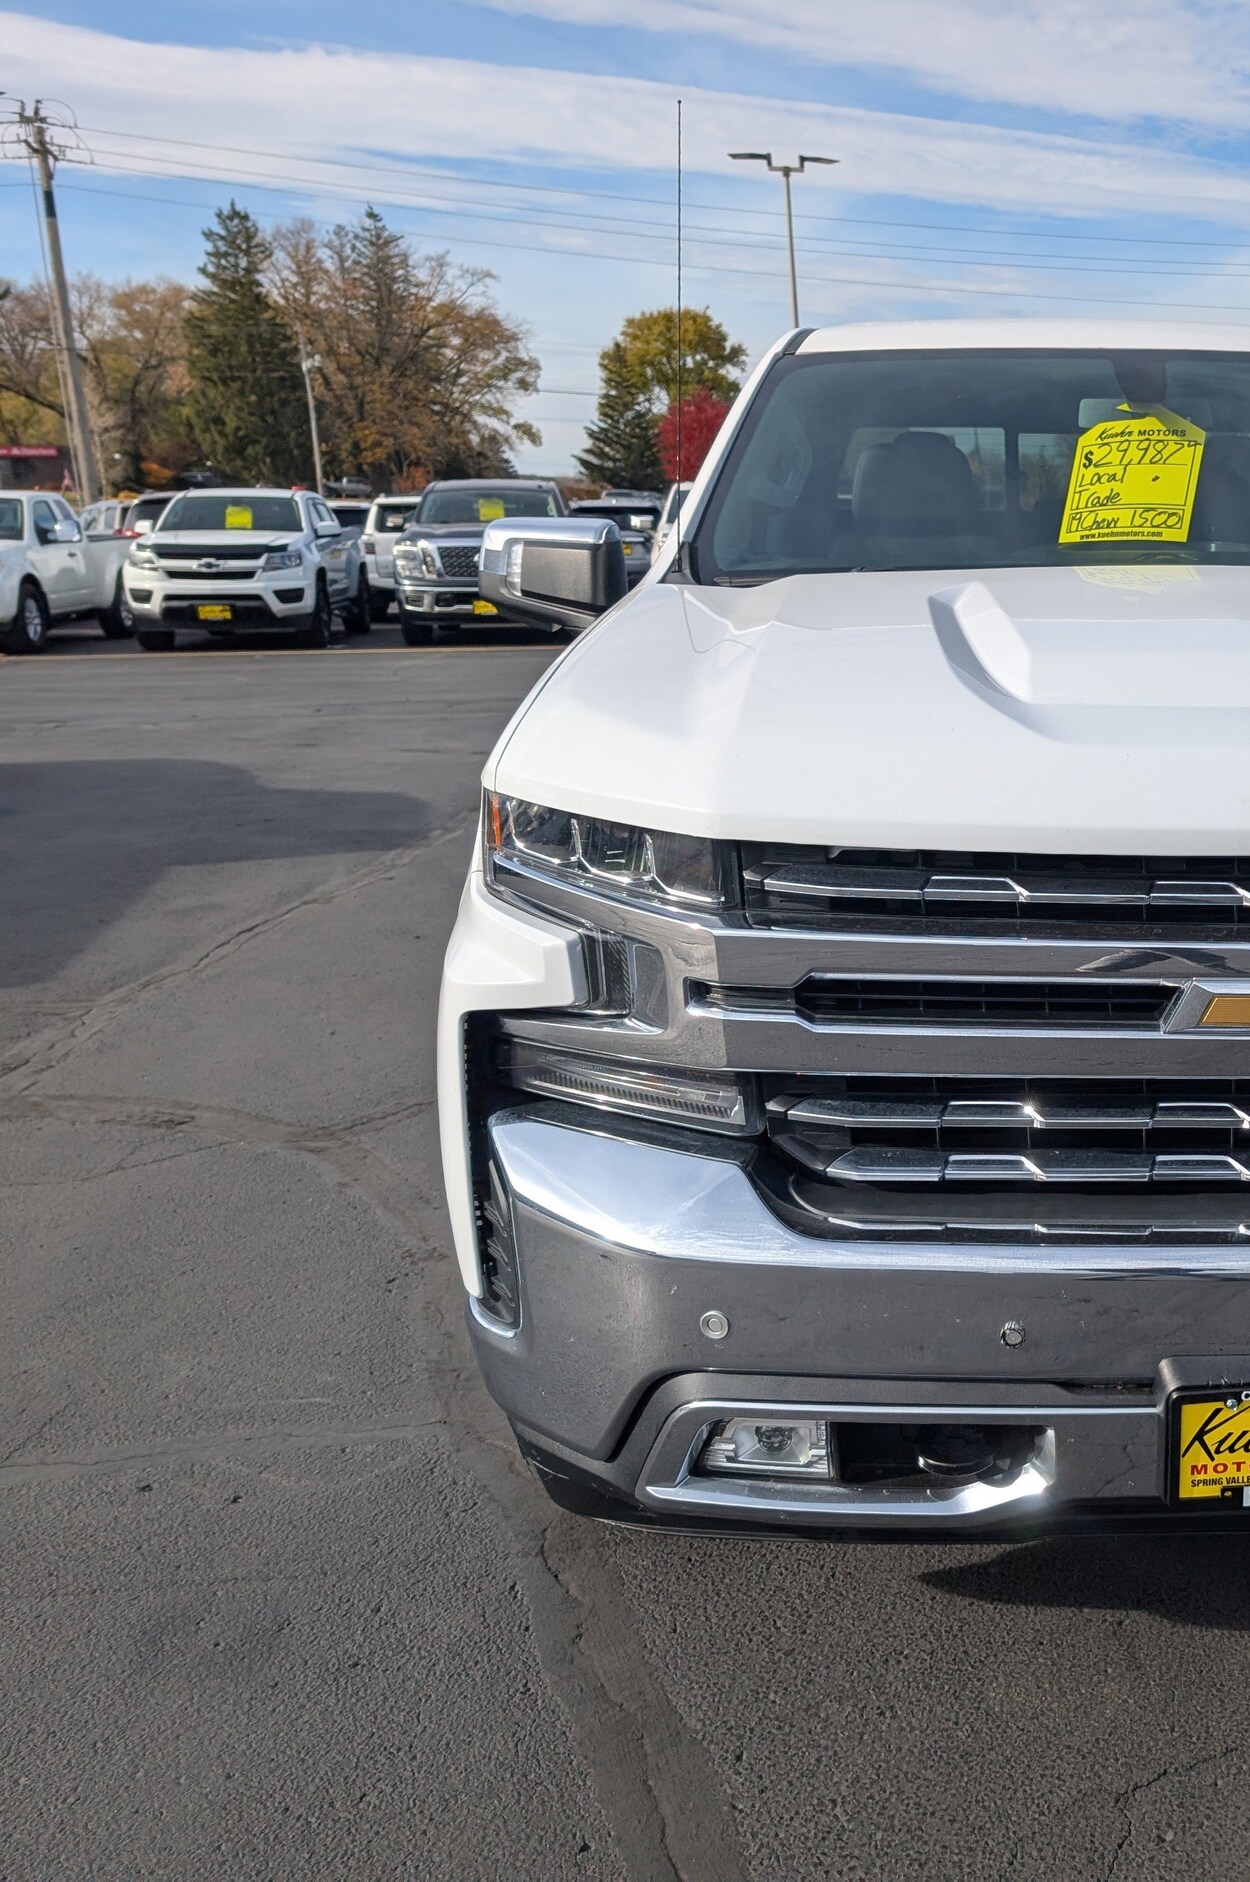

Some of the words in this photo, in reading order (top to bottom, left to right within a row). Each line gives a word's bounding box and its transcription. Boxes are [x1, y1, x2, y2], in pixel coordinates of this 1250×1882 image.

[1137, 429, 1187, 437] MOTORS
[1079, 467, 1127, 488] Local
[1075, 488, 1122, 510] Trade
[1130, 509, 1181, 528] 1500
[1080, 531, 1163, 540] www.kuehnmotors.com
[1190, 1476, 1223, 1487] SPRING
